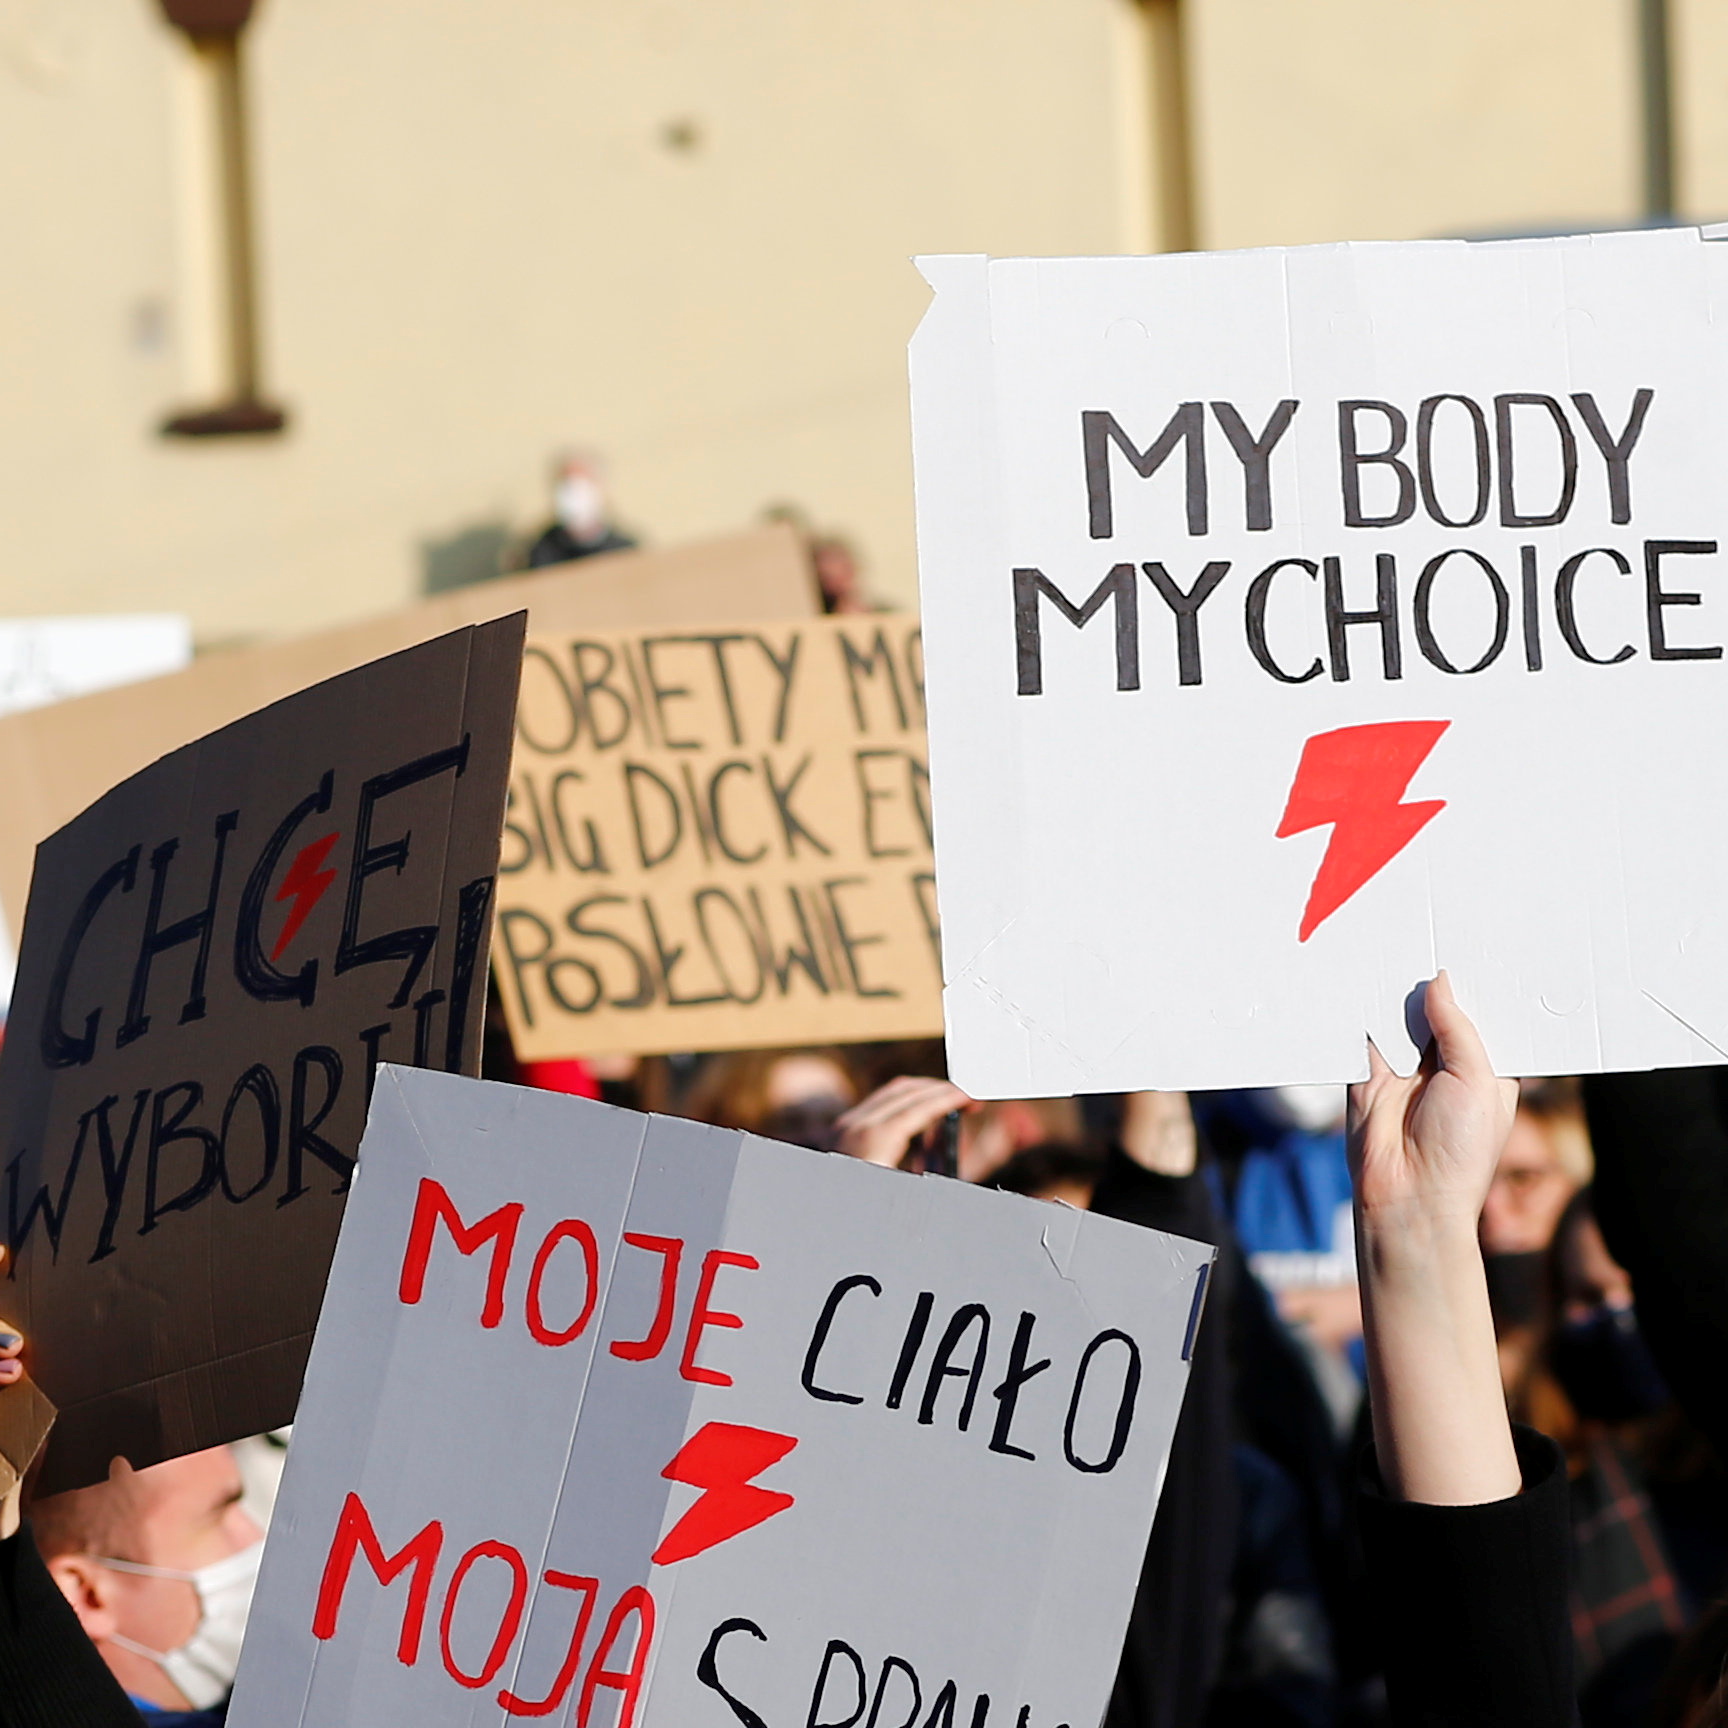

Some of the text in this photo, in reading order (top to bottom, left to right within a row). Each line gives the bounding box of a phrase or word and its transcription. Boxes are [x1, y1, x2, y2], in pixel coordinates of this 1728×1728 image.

[1080, 387, 1655, 540] MY BODY
[518, 632, 800, 755] OBIETY
[1011, 539, 1725, 697] MY CHOICE
[623, 754, 833, 871] DICK
[38, 733, 472, 1070] CHCĘ
[397, 1176, 1142, 1475] MOJE CIAŁO
